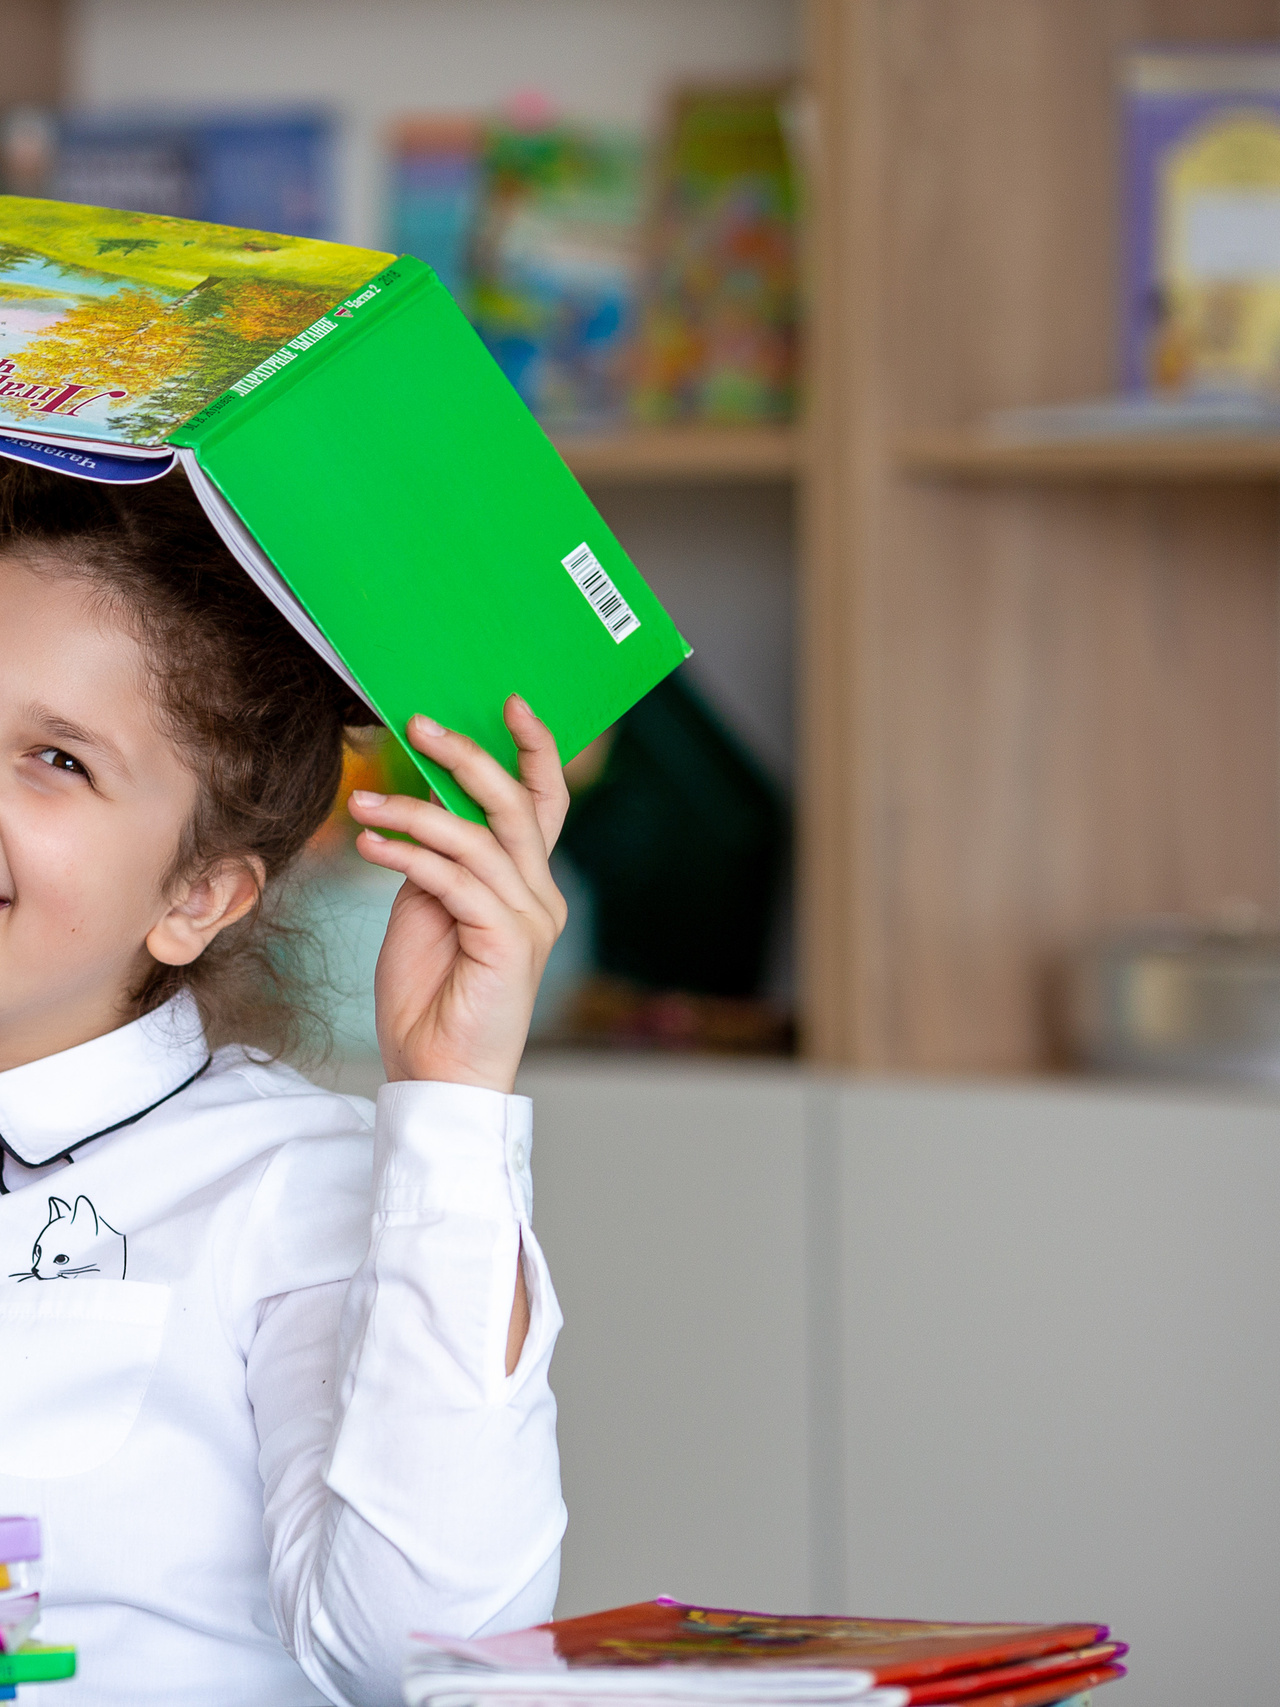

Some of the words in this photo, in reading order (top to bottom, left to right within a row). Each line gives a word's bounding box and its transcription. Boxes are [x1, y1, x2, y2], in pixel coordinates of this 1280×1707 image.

[287, 316, 339, 352] ЧЫТАННЕ
[344, 290, 377, 309] Частка
[368, 284, 382, 293] 2
[378, 269, 401, 287] 2018
